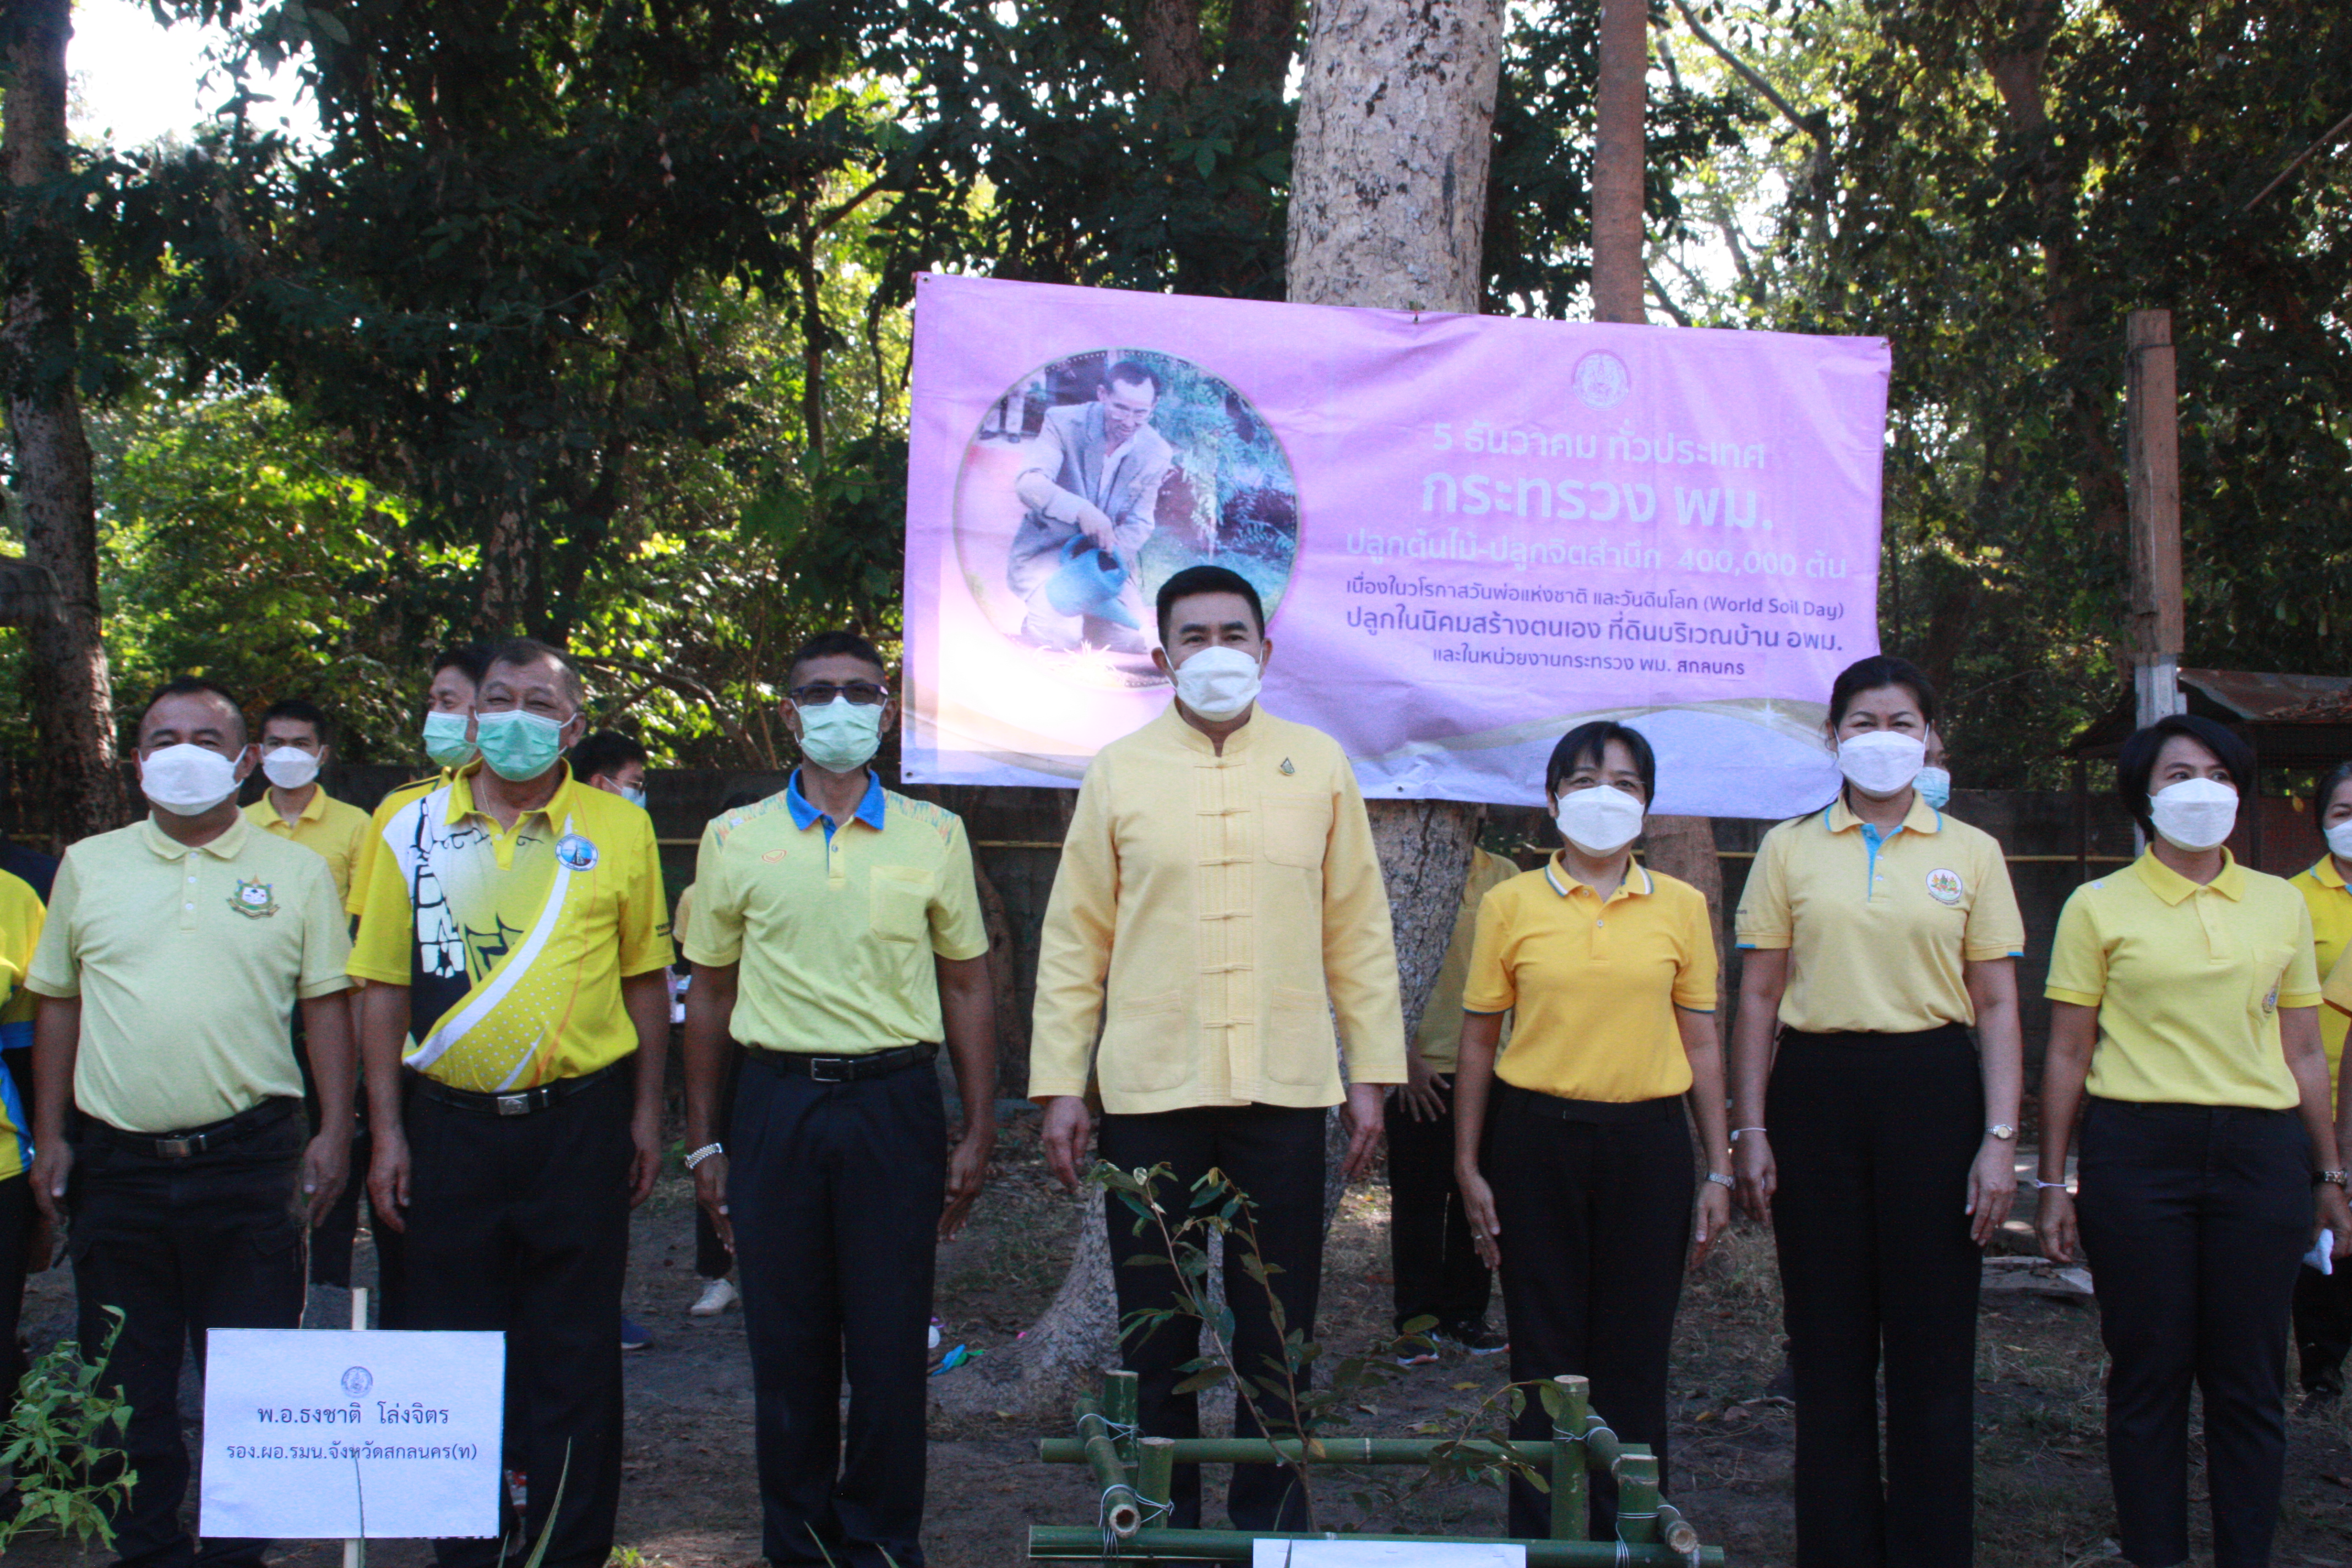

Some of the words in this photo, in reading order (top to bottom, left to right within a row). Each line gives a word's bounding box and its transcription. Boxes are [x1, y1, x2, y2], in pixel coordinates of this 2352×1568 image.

[1432, 422, 1453, 450] 5
[1464, 418, 1597, 459] ธันวาคม
[1608, 418, 1765, 469] ทั่วประเทศ
[1422, 472, 1657, 522] กระทรวง
[1674, 486, 1773, 529] พม.
[1676, 547, 1797, 578] 400,000
[1805, 549, 1847, 579] ต้น
[1593, 589, 1698, 611] และวันดินโลก
[1703, 595, 1763, 615] (World
[1768, 598, 1799, 616] Soil
[1803, 601, 1844, 621] Day)
[1346, 603, 1602, 639] ปลูกในนิคมสร้างตนเอง
[1608, 611, 1779, 647] ที่ดินบริเวณบ้าน
[1786, 630, 1843, 651] อพม.
[1433, 643, 1635, 672] และในหน่วยงานกระทรวง
[1640, 660, 1671, 673] พม.
[1677, 660, 1745, 676] สกลนคร
[258, 1402, 361, 1424] พ.อ.ธงชาติ
[377, 1401, 449, 1424] โล่งจิตร
